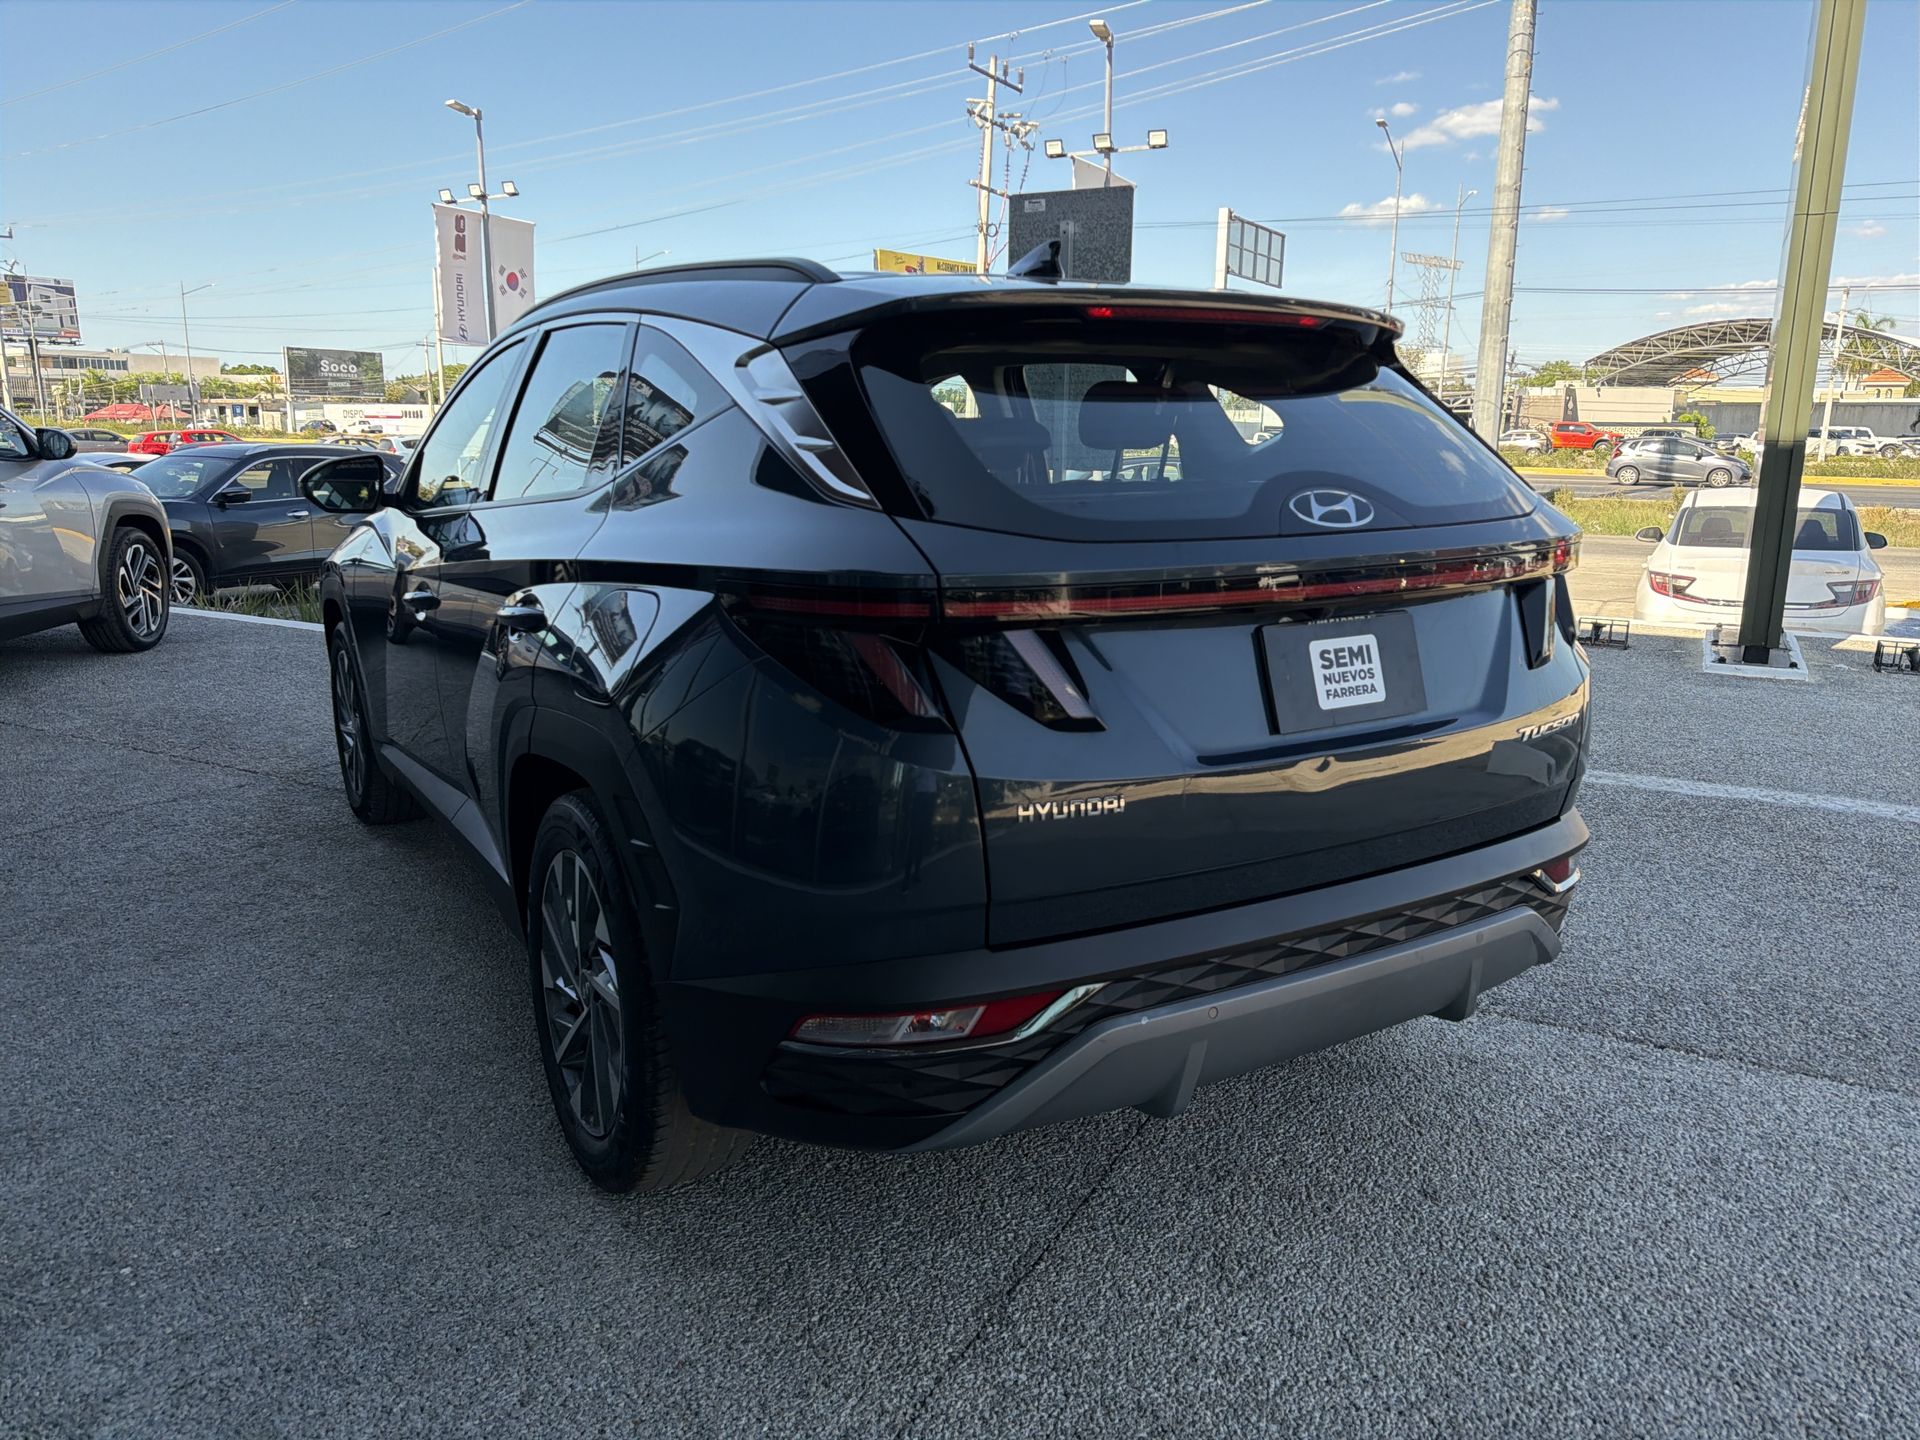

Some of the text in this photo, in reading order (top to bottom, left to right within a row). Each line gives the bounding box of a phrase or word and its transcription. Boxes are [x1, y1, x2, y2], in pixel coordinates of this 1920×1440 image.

[456, 273, 466, 321] HYUNDAI
[320, 359, 357, 373] Soco
[1319, 644, 1373, 670] SEMI
[1322, 667, 1375, 685] NUEVOS
[1325, 683, 1378, 700] FARRERA
[1017, 794, 1126, 823] HYUNDAI
